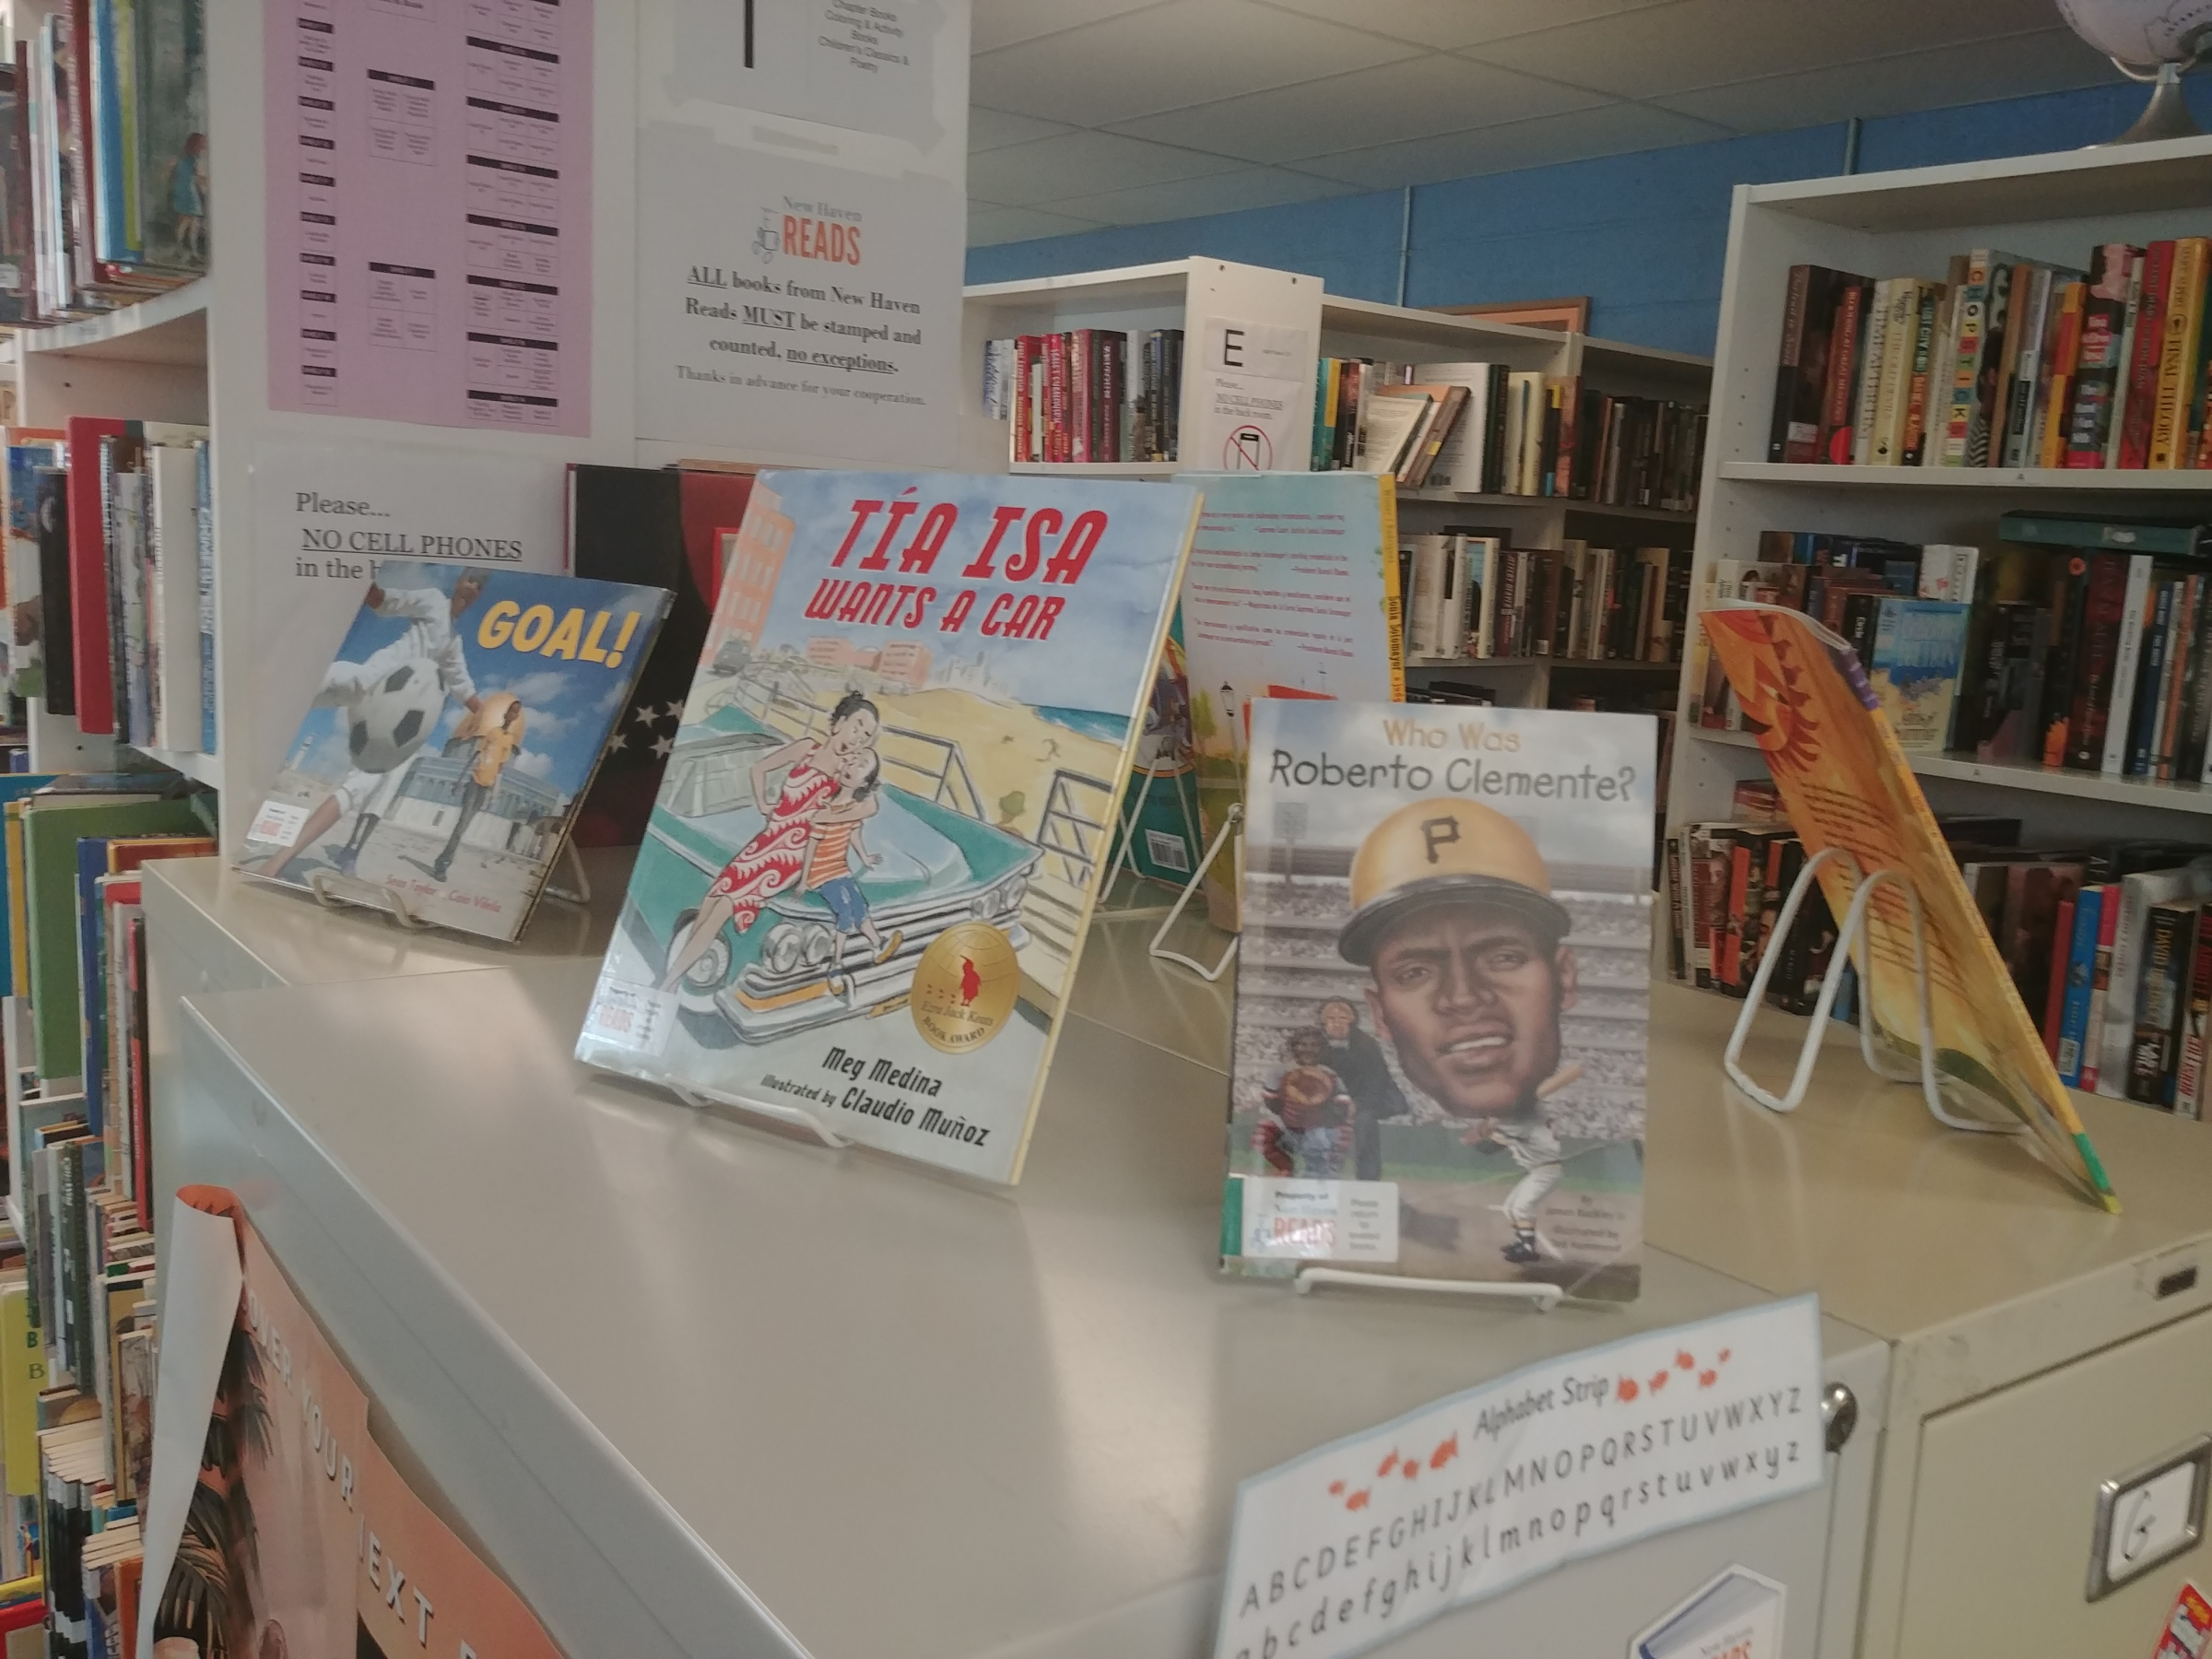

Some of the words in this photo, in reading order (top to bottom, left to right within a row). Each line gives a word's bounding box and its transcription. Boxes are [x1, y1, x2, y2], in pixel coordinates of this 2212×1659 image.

[783, 195, 813, 212] New
[817, 203, 862, 221] Haven
[782, 215, 861, 265] READS
[688, 265, 727, 288] ALL
[732, 271, 782, 293] books
[786, 280, 826, 301] from
[831, 286, 865, 305] New
[870, 291, 921, 314] Haven
[686, 297, 737, 320] Reads
[742, 305, 795, 329] MUST
[801, 313, 818, 331] be
[824, 320, 888, 343] stamped
[893, 329, 922, 345] and
[786, 348, 807, 362] no
[1223, 329, 1244, 367] E
[677, 365, 726, 382] Thanks
[729, 372, 742, 385] in
[746, 374, 798, 392] advance
[802, 381, 818, 394] for
[296, 492, 391, 517] Please...
[301, 528, 342, 549] NO
[348, 531, 413, 553] CELL
[420, 535, 523, 559] PHONES
[830, 487, 959, 574] TÍA
[961, 506, 1109, 584] ISA
[296, 557, 319, 577] in
[326, 559, 363, 579] the
[804, 578, 936, 629] WANTS
[939, 590, 977, 632] A
[981, 594, 1066, 641] CAR
[477, 600, 642, 669] GOAL!
[1382, 719, 1448, 748] Who
[1458, 722, 1522, 753] Was
[1268, 749, 1432, 791] Roberto
[1445, 758, 1637, 802] Clemente?
[1420, 815, 1461, 865] P
[822, 1046, 865, 1080] Meg
[868, 1058, 942, 1098] Medina
[821, 1092, 837, 1107] by
[841, 1087, 914, 1126] Claudio
[918, 1107, 991, 1147] Muñoz
[29, 1363, 44, 1379] B
[1561, 1374, 1609, 1407] Strip
[301, 1378, 353, 1512] YOUR
